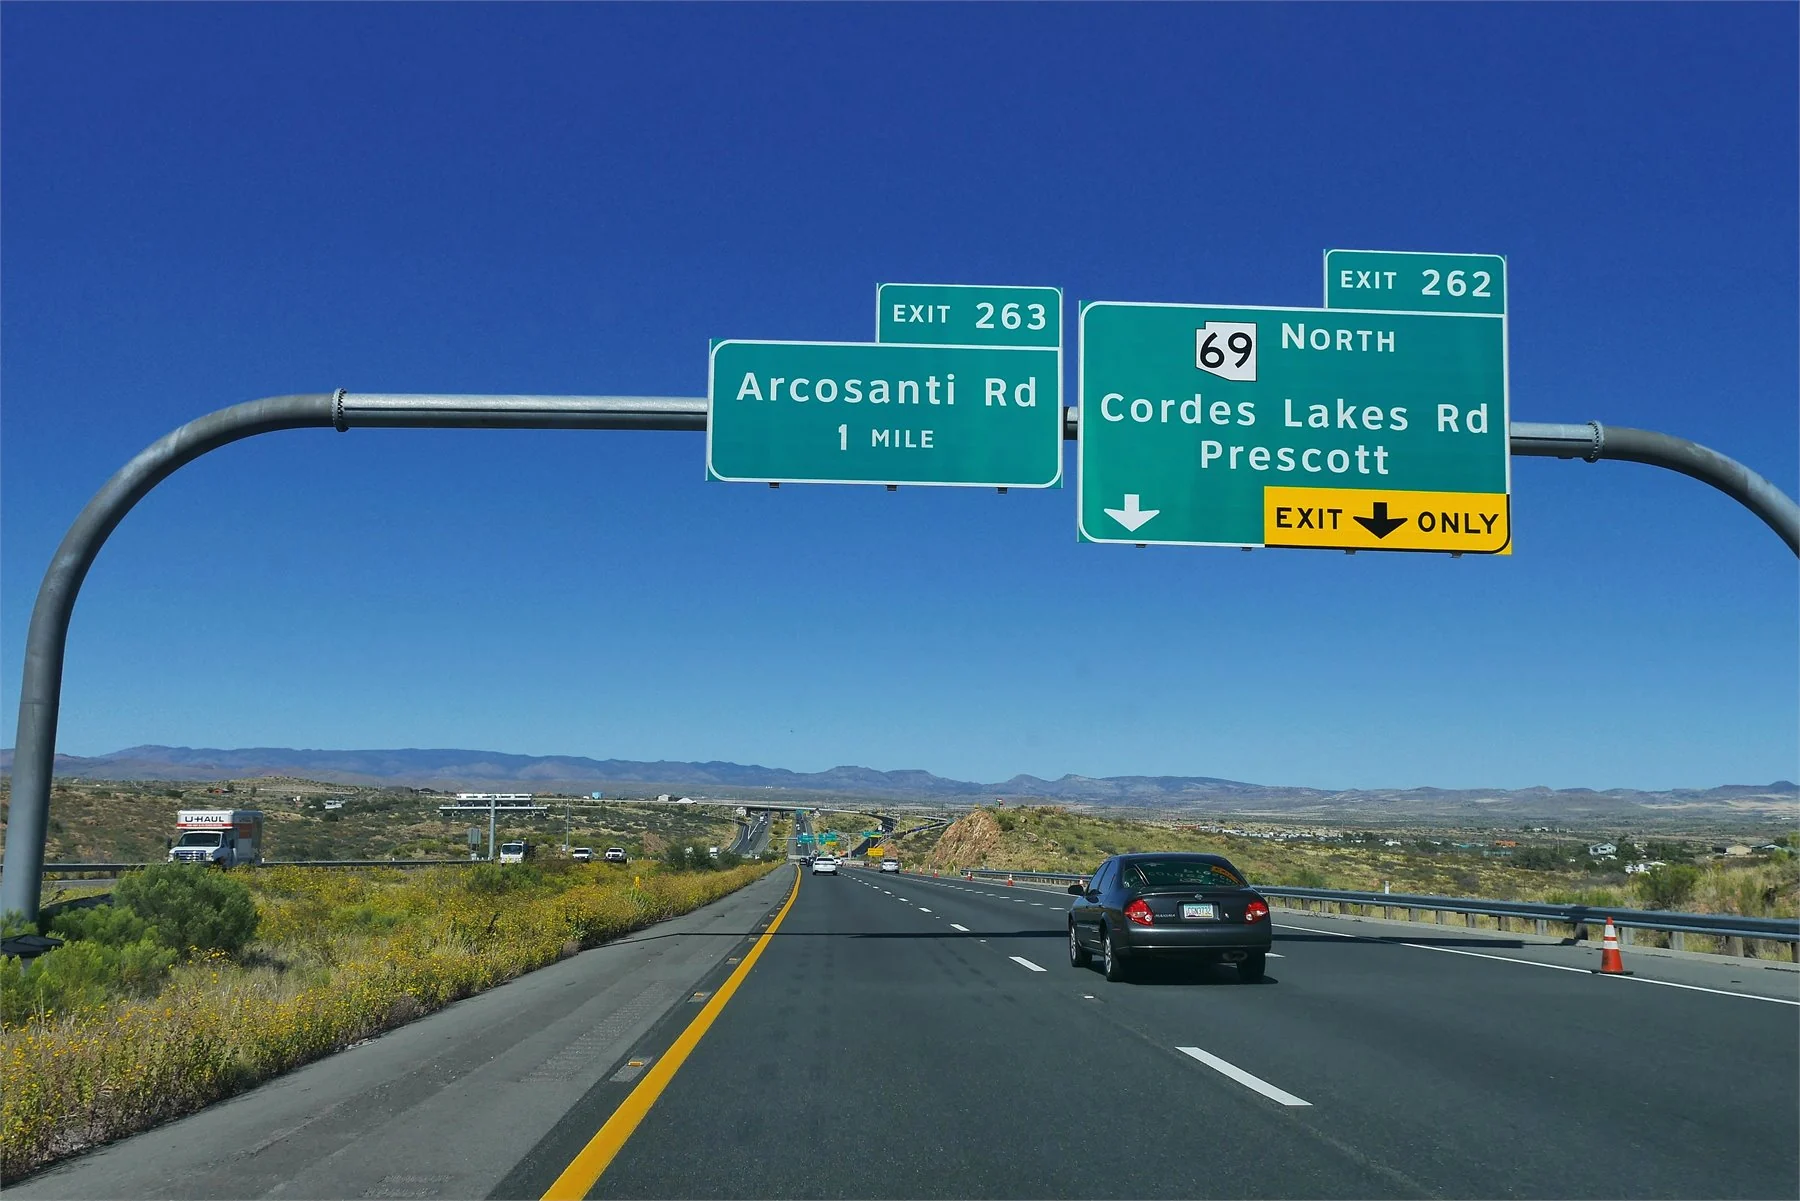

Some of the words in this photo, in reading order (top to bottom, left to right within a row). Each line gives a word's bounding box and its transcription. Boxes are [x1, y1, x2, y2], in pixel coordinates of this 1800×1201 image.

[1341, 270, 1397, 290] EXIT
[1421, 269, 1491, 297] 262
[893, 304, 951, 323] EXIT
[975, 302, 1046, 330] 263
[1199, 331, 1253, 369] 69
[1282, 322, 1395, 353] NORTH
[736, 372, 955, 405] Arcosanti
[985, 376, 1036, 407] Rd
[1101, 393, 1256, 426] Cordes
[1285, 398, 1408, 431] Lakes
[1437, 403, 1488, 434] Rd
[838, 424, 848, 451] 1
[871, 429, 934, 448] MILE
[1201, 440, 1389, 475] Prescott
[1276, 507, 1343, 530] EXIT
[1417, 511, 1499, 534] ONLY
